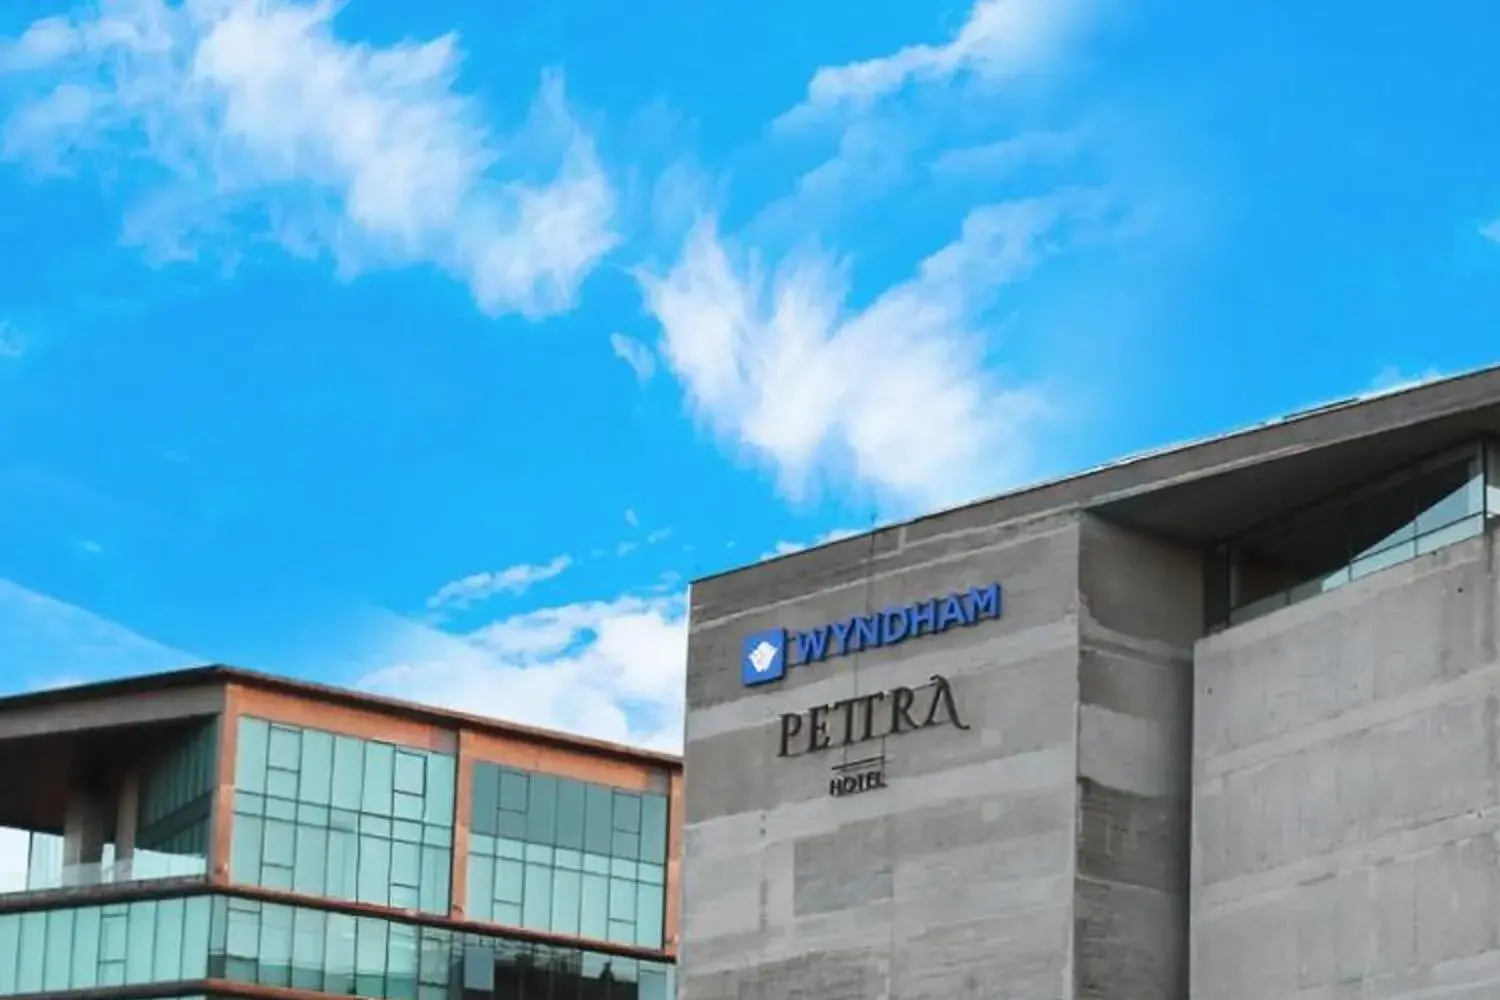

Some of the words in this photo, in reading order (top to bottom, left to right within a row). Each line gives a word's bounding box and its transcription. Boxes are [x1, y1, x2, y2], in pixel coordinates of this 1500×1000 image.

[795, 582, 1002, 664] WYNDHAM
[778, 674, 970, 757] PETTRA
[829, 771, 887, 797] HOTEL
